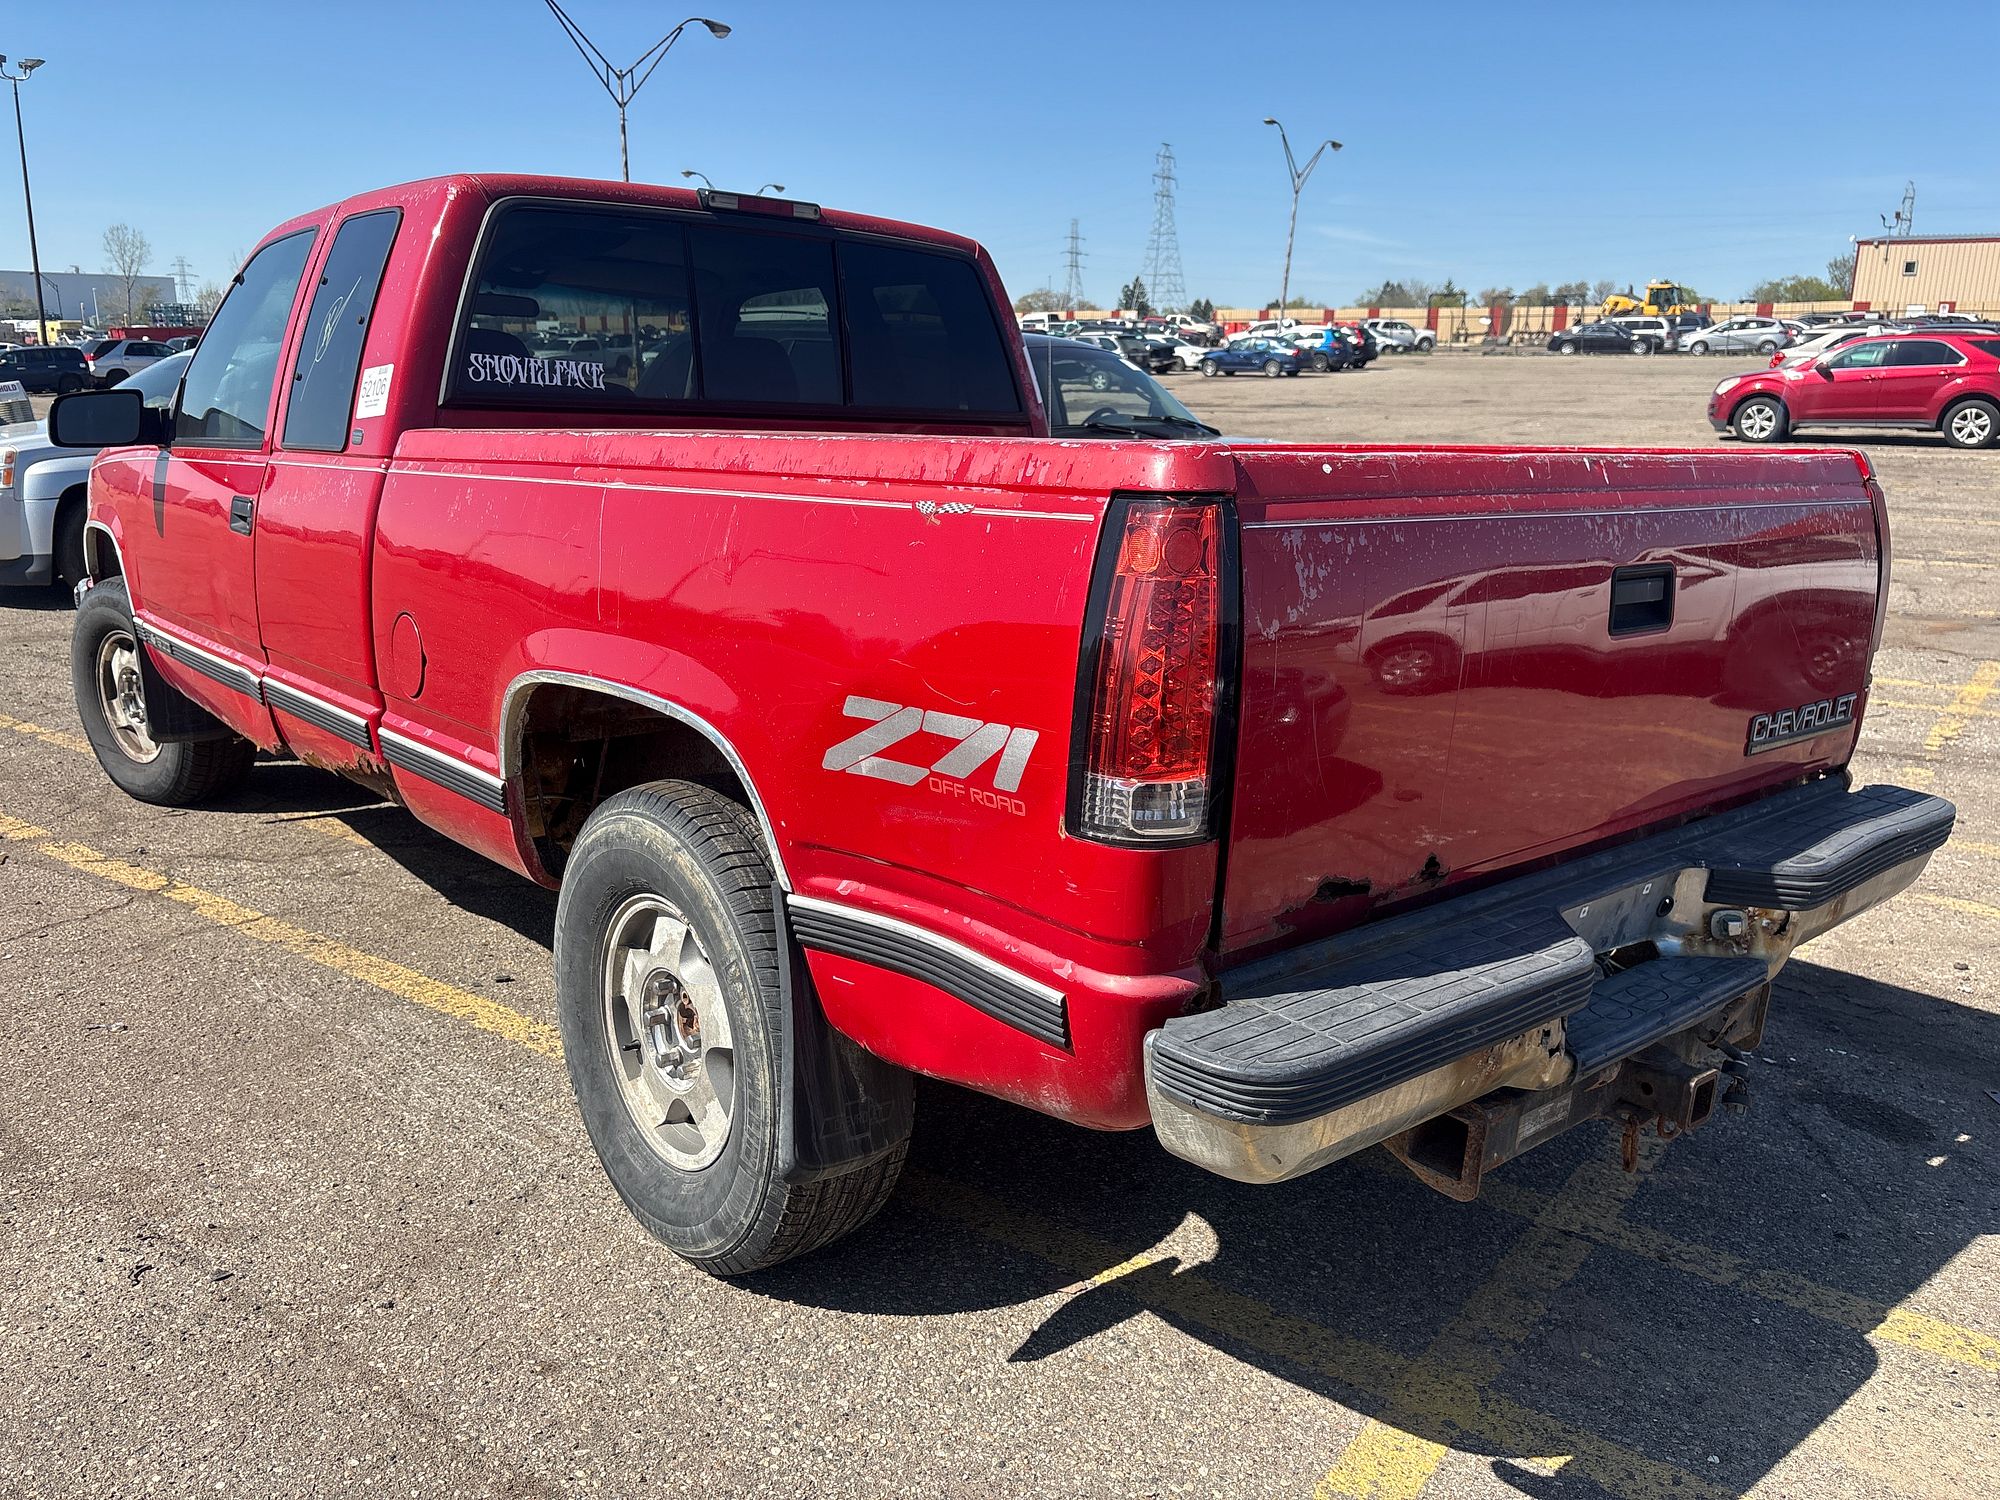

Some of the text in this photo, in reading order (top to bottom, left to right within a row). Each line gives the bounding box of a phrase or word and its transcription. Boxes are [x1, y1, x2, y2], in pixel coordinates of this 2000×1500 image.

[362, 378, 387, 398] 52106
[468, 352, 605, 391] SHOVELFACE
[1752, 692, 1857, 742] CHEVROLET
[822, 695, 1039, 793] Z71
[929, 777, 1026, 817] OFF ROAD
